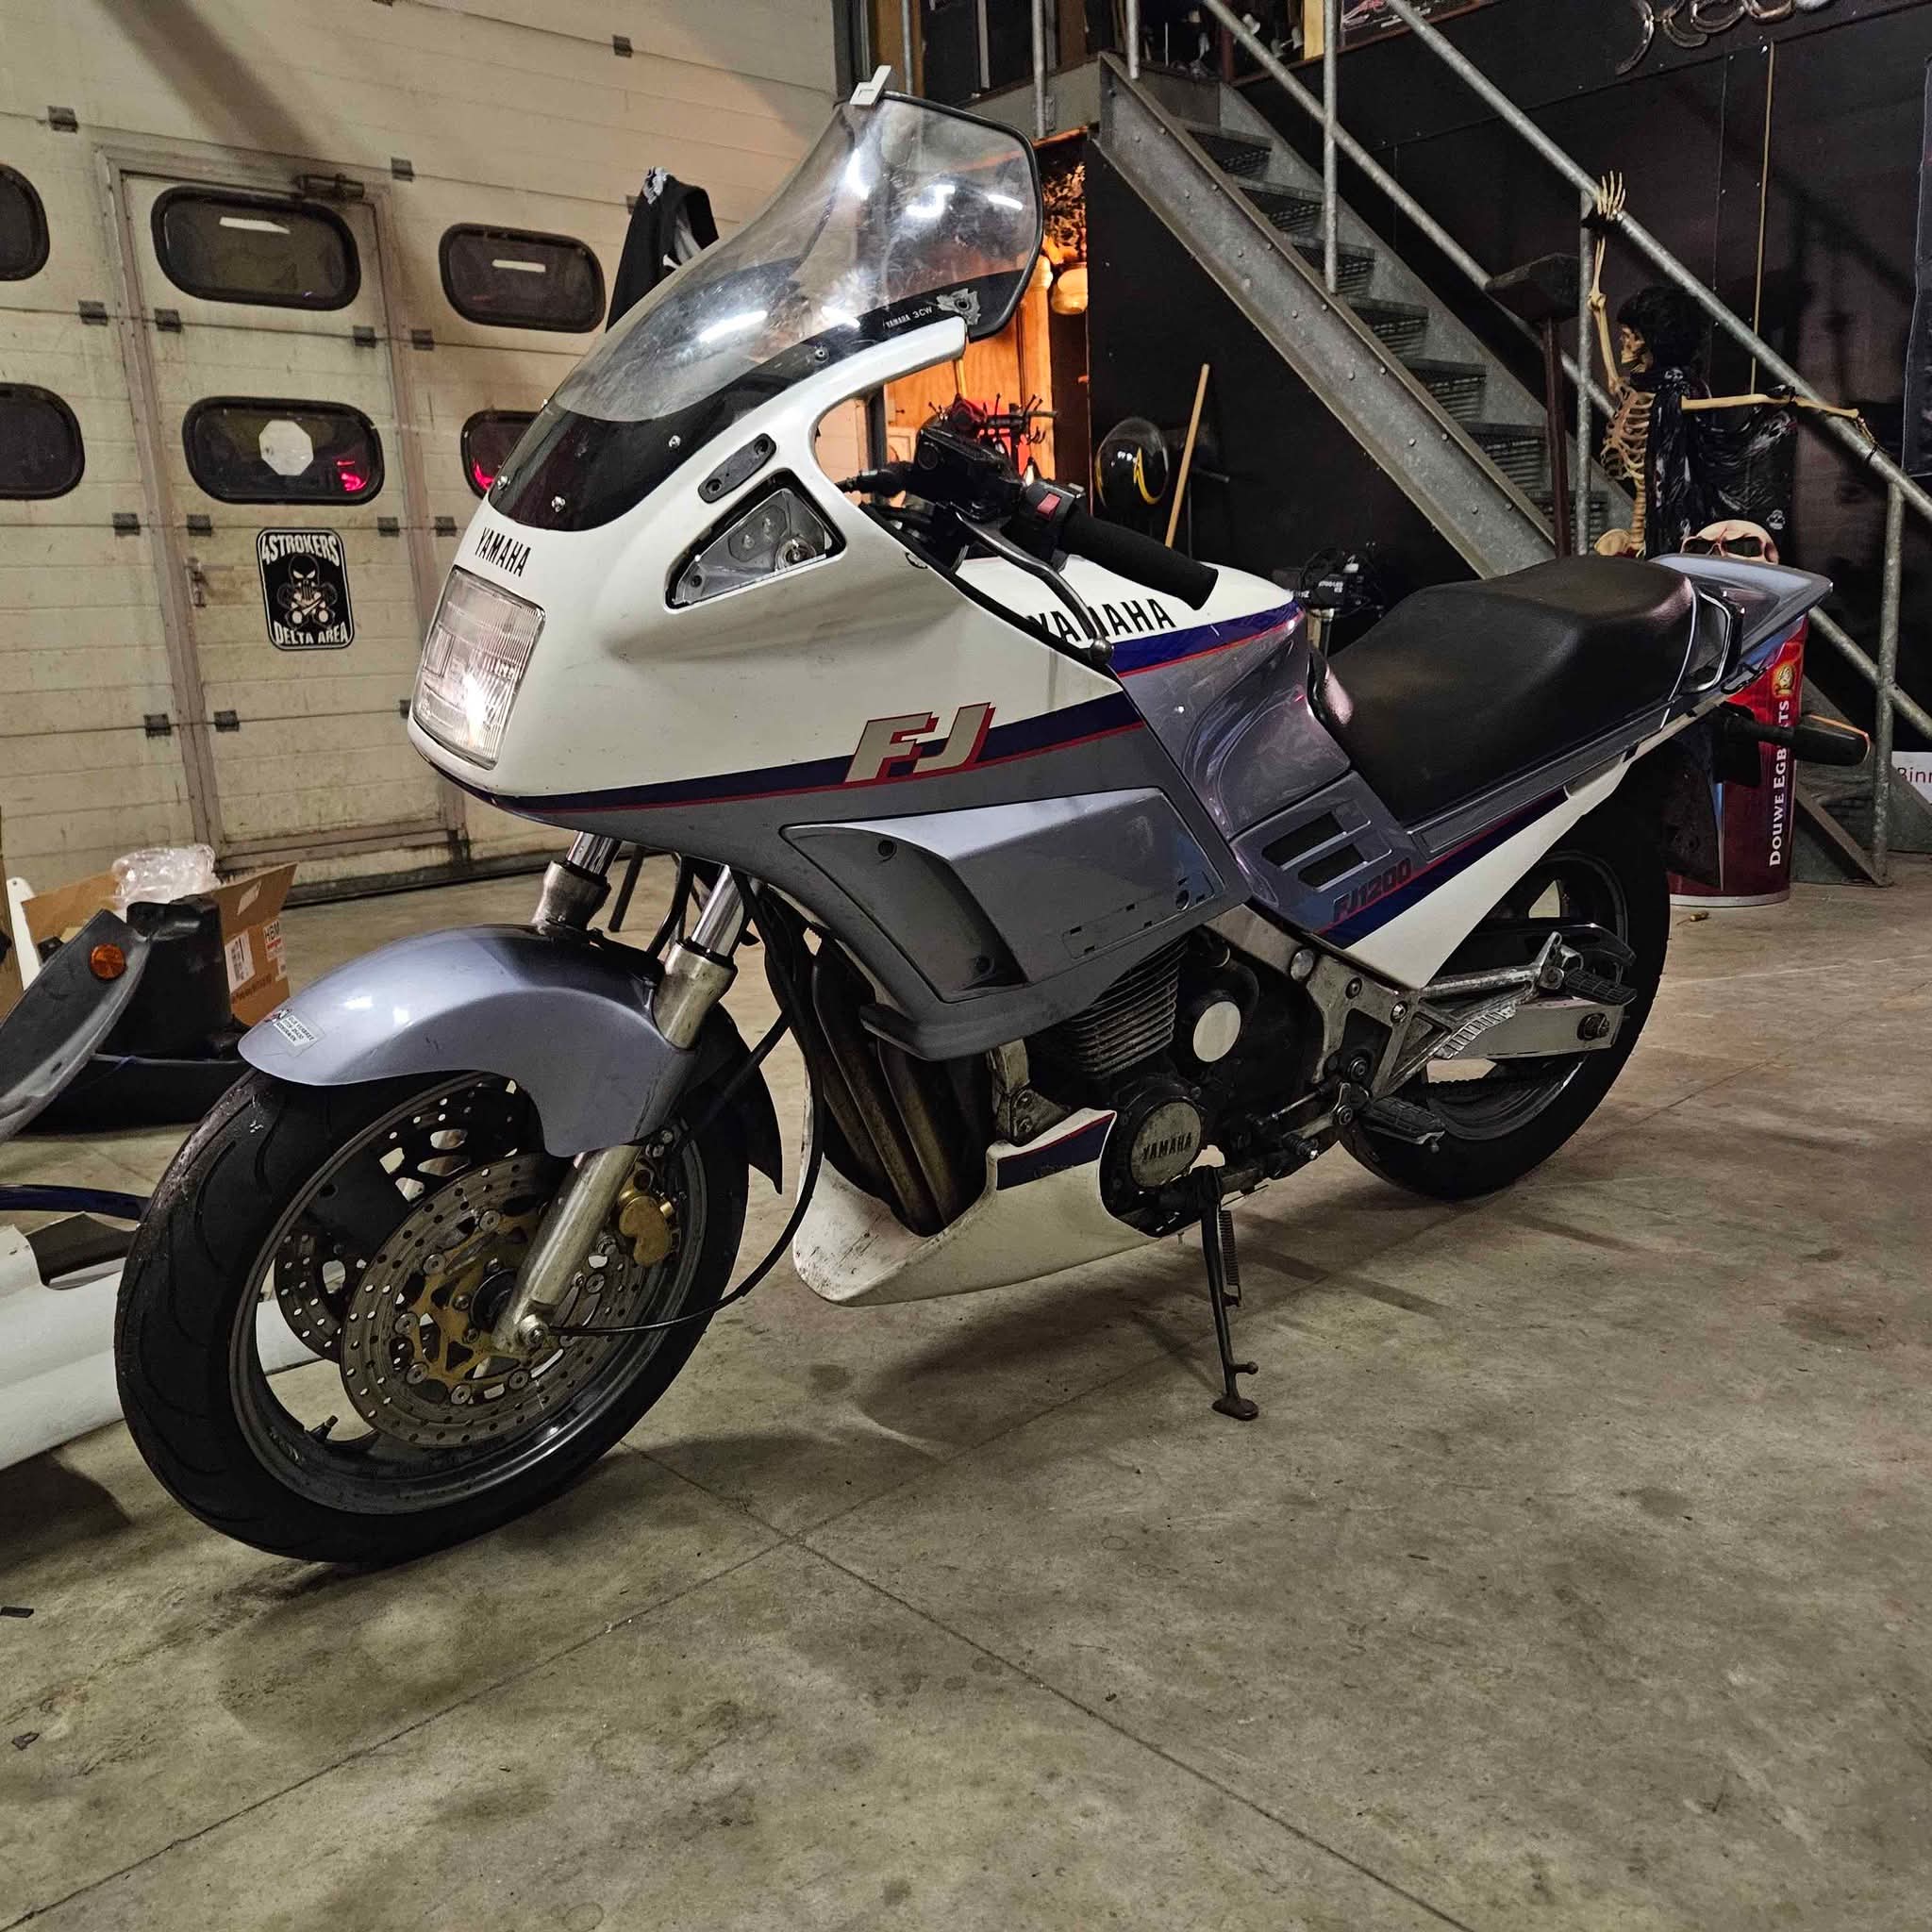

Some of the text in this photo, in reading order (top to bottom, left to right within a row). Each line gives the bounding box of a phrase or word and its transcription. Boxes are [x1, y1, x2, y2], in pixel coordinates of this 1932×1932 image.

[912, 307, 933, 319] 3CW
[261, 534, 340, 566] 4STROKERS
[475, 527, 531, 577] YAMAHA
[274, 621, 348, 644] DELTA AREA
[845, 702, 996, 782] FJ
[1770, 700, 1790, 866] DOUWE EGBTS
[1332, 858, 1412, 924] FJ1200
[1141, 1131, 1192, 1163] YAMAHA
